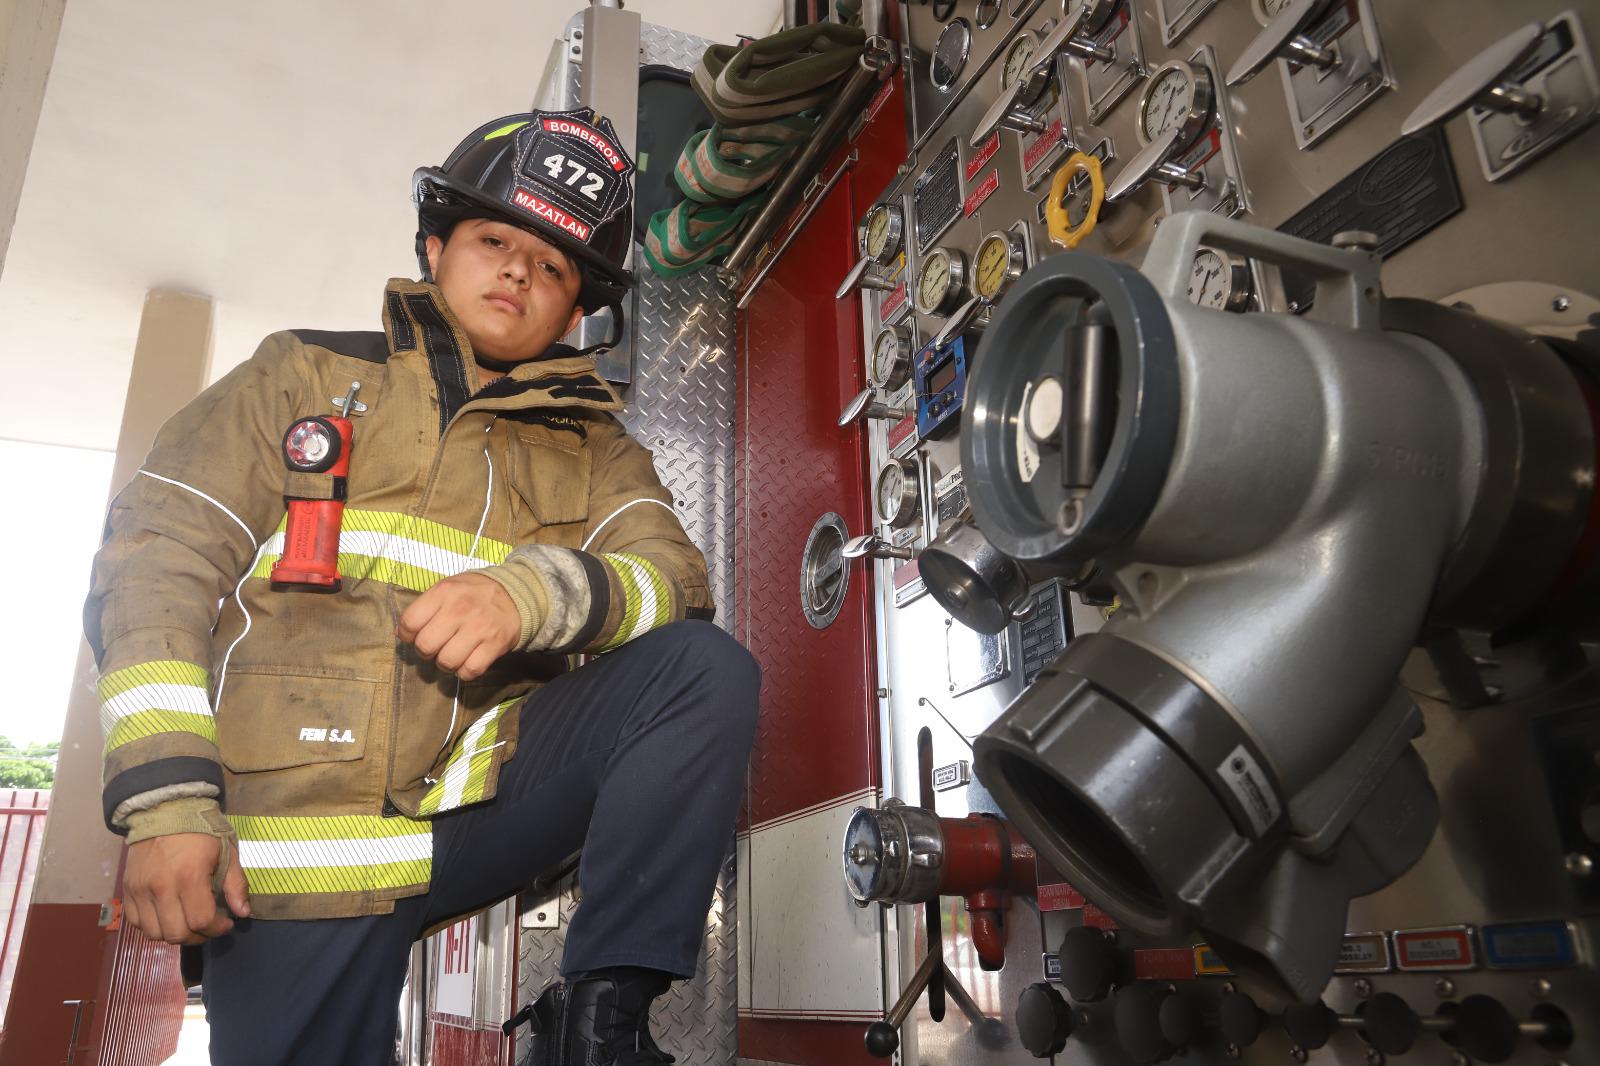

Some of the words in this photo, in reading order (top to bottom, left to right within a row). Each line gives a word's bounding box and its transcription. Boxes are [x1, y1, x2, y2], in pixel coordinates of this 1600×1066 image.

[550, 121, 619, 165] BOMBEROS
[543, 153, 604, 201] 472
[515, 192, 587, 238] MAZATLAN
[299, 728, 327, 741] FEM
[329, 729, 355, 743] S.A.
